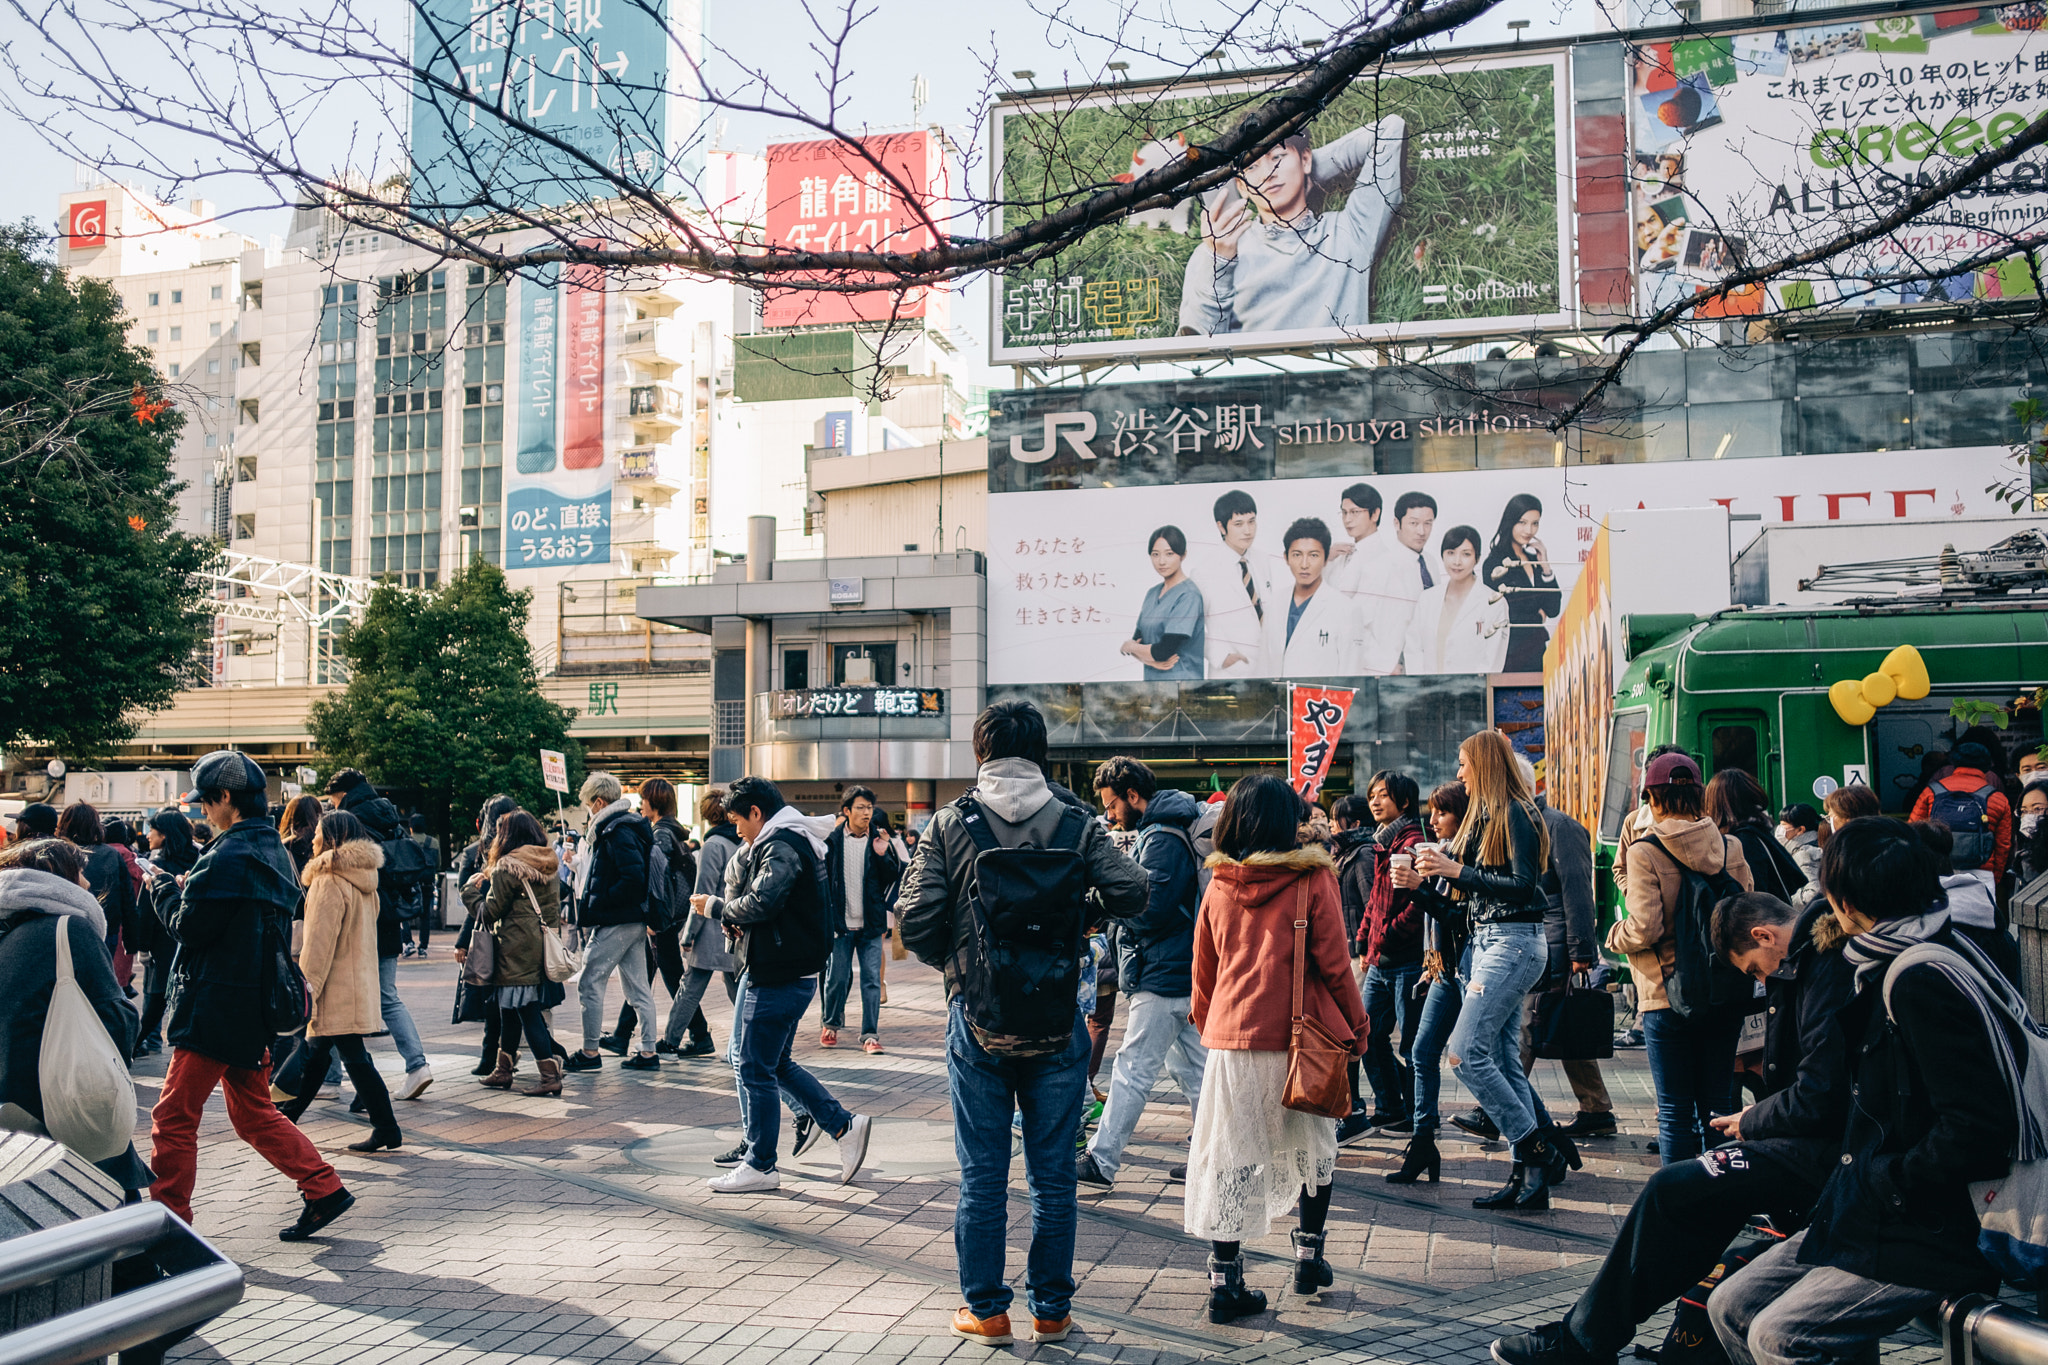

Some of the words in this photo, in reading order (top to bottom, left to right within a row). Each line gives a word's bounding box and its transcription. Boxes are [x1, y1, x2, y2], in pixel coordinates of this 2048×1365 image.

[469, 0, 603, 54] 龍角散
[451, 42, 630, 131] ダイレクト
[1420, 127, 1501, 144] スマホがやっと
[799, 171, 893, 220] 龍角散
[1768, 179, 1854, 217] ALL
[1007, 275, 1160, 331] ギガモン
[1453, 280, 1540, 302] SoftBank
[1010, 411, 1098, 464] JR
[1110, 403, 1265, 458] 渋谷駅
[1278, 417, 1408, 446] shibuya
[1419, 409, 1532, 439] station
[511, 502, 609, 533] のど、直接、
[520, 534, 594, 562] うるおう
[1015, 537, 1086, 556] あなたを
[1015, 572, 1118, 592] 救うために、
[1015, 605, 1112, 626] 生きてきた。
[588, 681, 619, 717] 駅
